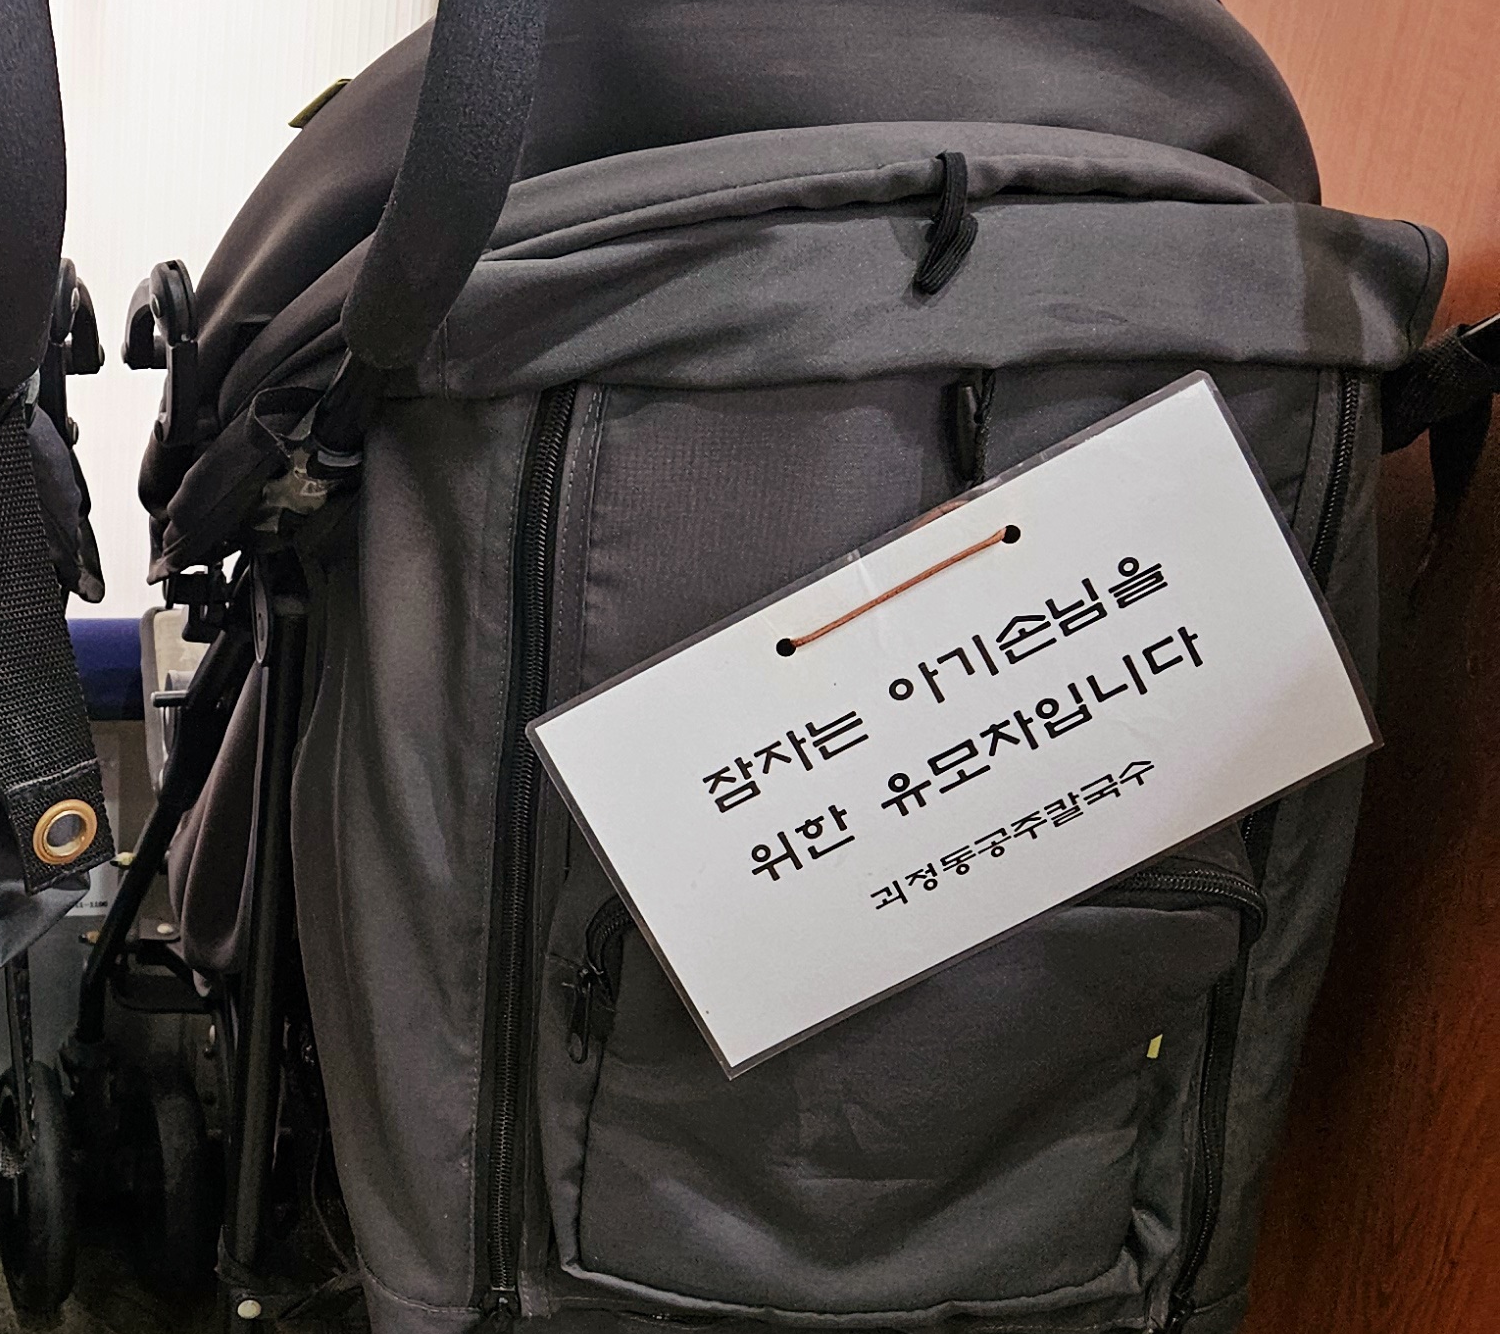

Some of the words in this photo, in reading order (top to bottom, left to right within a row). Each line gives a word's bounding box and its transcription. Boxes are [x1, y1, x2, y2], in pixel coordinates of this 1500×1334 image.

[702, 710, 869, 814] 잠자는
[889, 556, 1169, 704] 아기손님을
[751, 804, 856, 882] 위한
[880, 626, 1204, 817] 유모차입니다
[870, 760, 1155, 910] 괴정동공주칼국수
